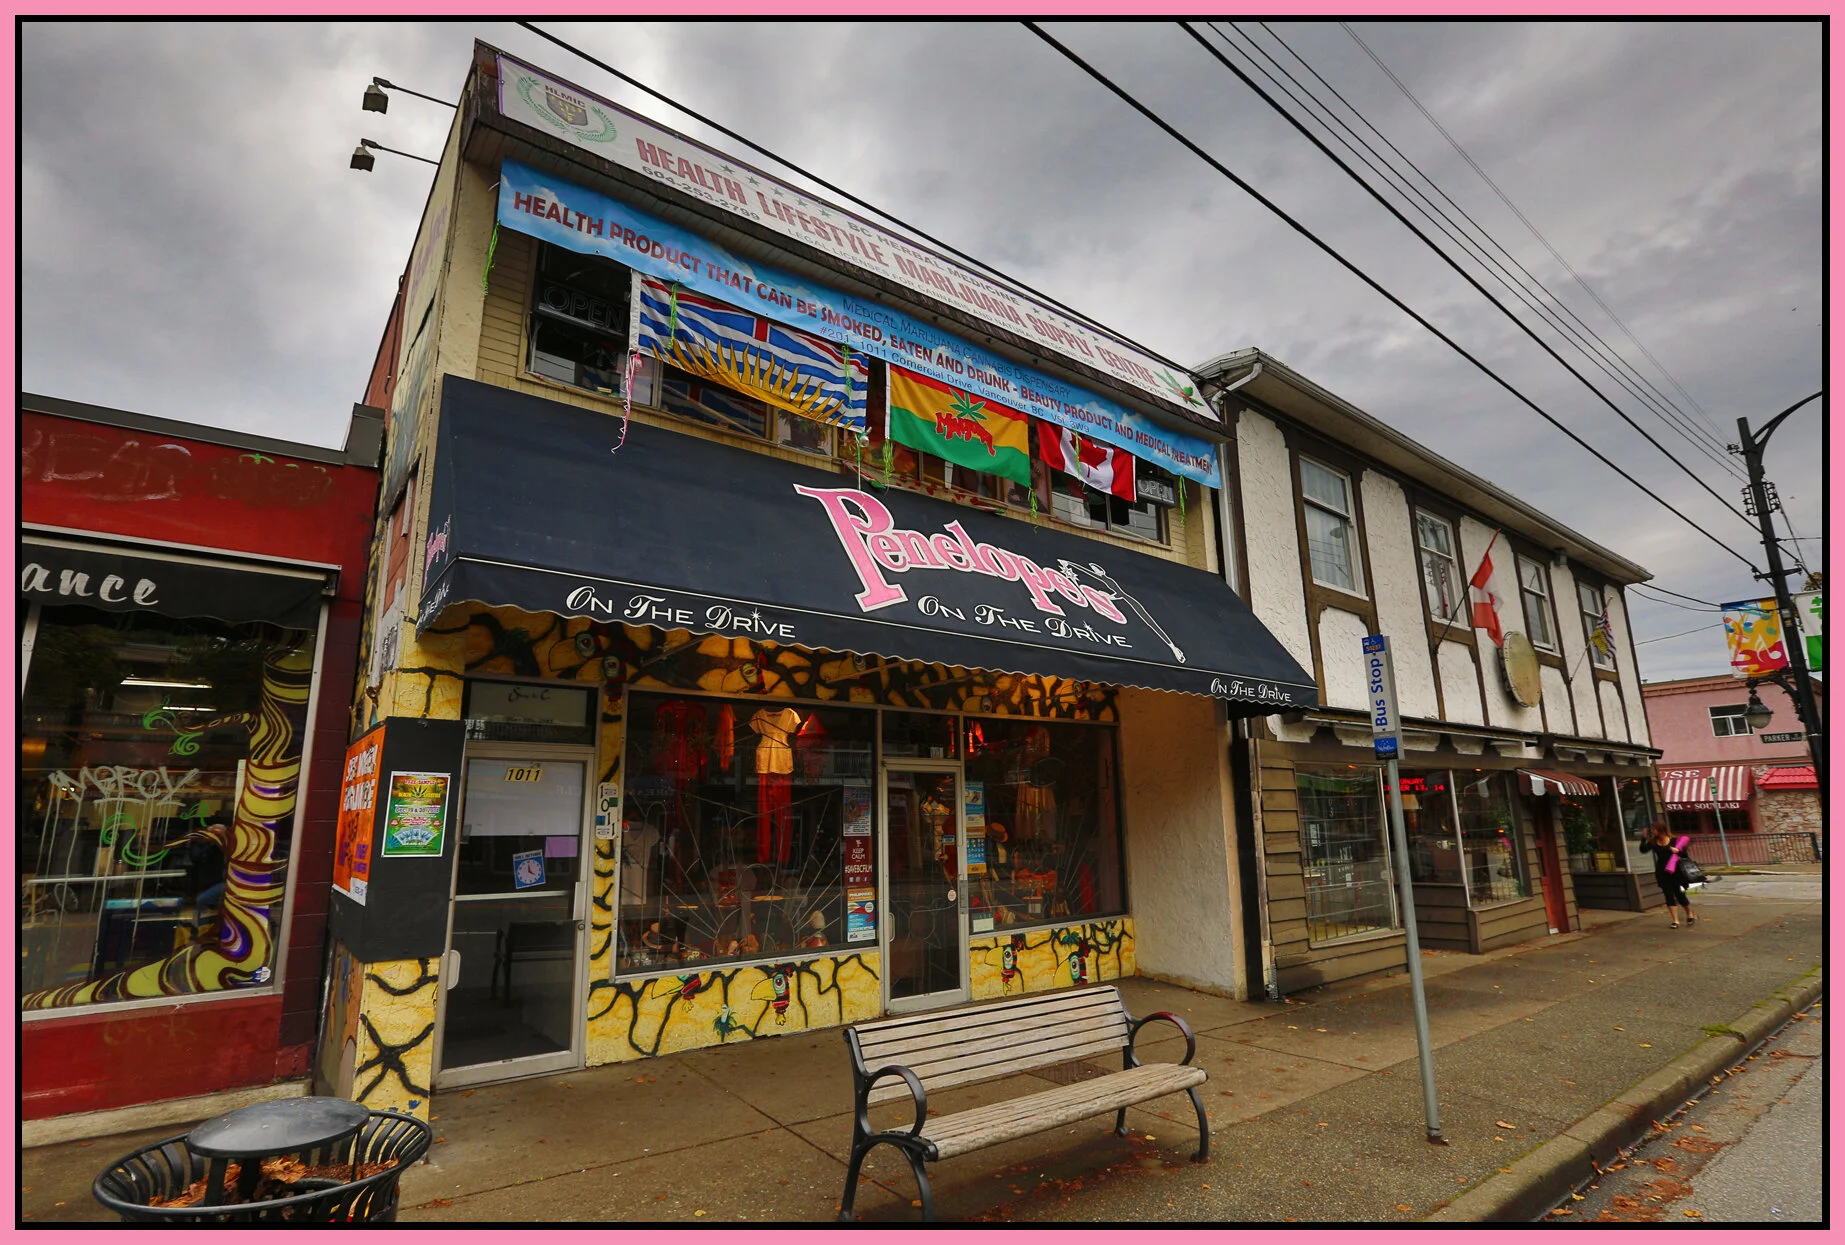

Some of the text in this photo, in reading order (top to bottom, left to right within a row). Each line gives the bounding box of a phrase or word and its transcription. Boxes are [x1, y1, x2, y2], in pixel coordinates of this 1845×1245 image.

[642, 165, 760, 220] 604-253-2799
[635, 137, 1160, 388] HEALTH LIFESTYLE MARIJUANA SUPPLY CENTRE
[788, 228, 832, 252] LEGAL
[832, 247, 890, 277] LICENSES
[892, 273, 915, 285] FOR
[917, 284, 971, 312] CANNABIS
[847, 221, 1021, 306] BC HERBAL MEDICINE
[513, 191, 604, 236] HEALTH
[609, 222, 702, 274] PRODUCT
[706, 261, 753, 293] THAT
[757, 282, 792, 310] CAN
[796, 299, 817, 319] BE
[821, 307, 887, 346] SMOKED,
[890, 334, 933, 364] EATEN
[936, 353, 964, 374] AND
[967, 364, 1011, 393] DRUNK
[1020, 384, 1061, 412] BEAUTY
[1064, 402, 1113, 430] PRODUCT
[1115, 421, 1134, 441] AND
[1135, 432, 1171, 457] MEDICAL
[1171, 445, 1213, 475] TREATMENT
[543, 285, 625, 333] OPEN
[842, 299, 1071, 399] MEDICAL MARIJUANA CANNABIS DISPENSARY
[860, 341, 886, 357] 1011
[891, 352, 944, 380] Comercial
[1031, 405, 1044, 416] BC
[21, 562, 159, 606] ance
[1370, 658, 1384, 693] Stop
[1374, 699, 1389, 727] Bus
[1763, 733, 1791, 742] PARKER
[508, 769, 541, 781] 1011
[1398, 777, 1425, 785] ONDAY
[1666, 803, 1683, 811] STA
